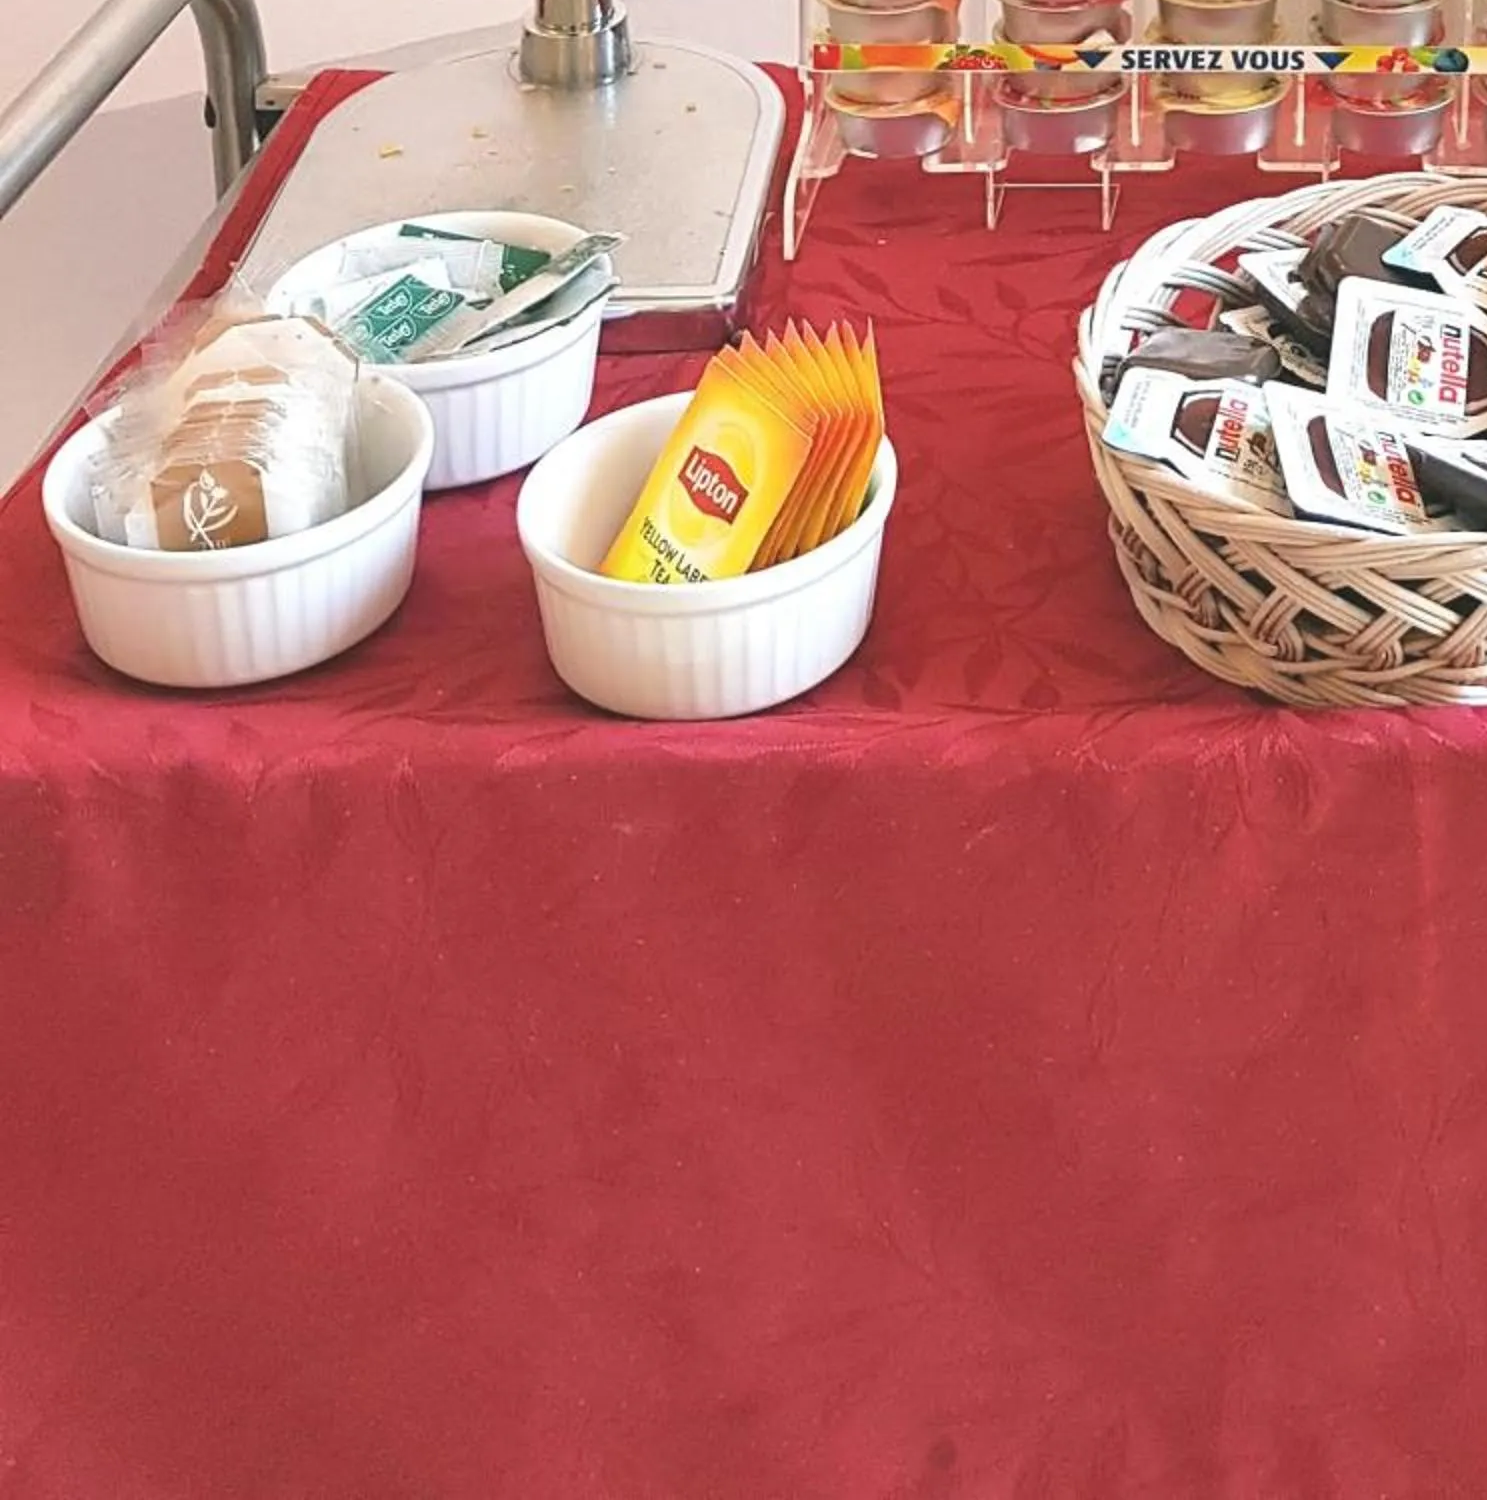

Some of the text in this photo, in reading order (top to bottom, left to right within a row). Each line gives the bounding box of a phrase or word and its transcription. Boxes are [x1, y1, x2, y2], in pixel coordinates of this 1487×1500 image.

[1121, 50, 1304, 70] SERVEZ VOUS
[1439, 324, 1468, 404] nutella
[1214, 397, 1249, 463] nutella
[685, 452, 739, 514] Lipton
[1375, 430, 1420, 506] nutella
[640, 515, 679, 563] YELLOW
